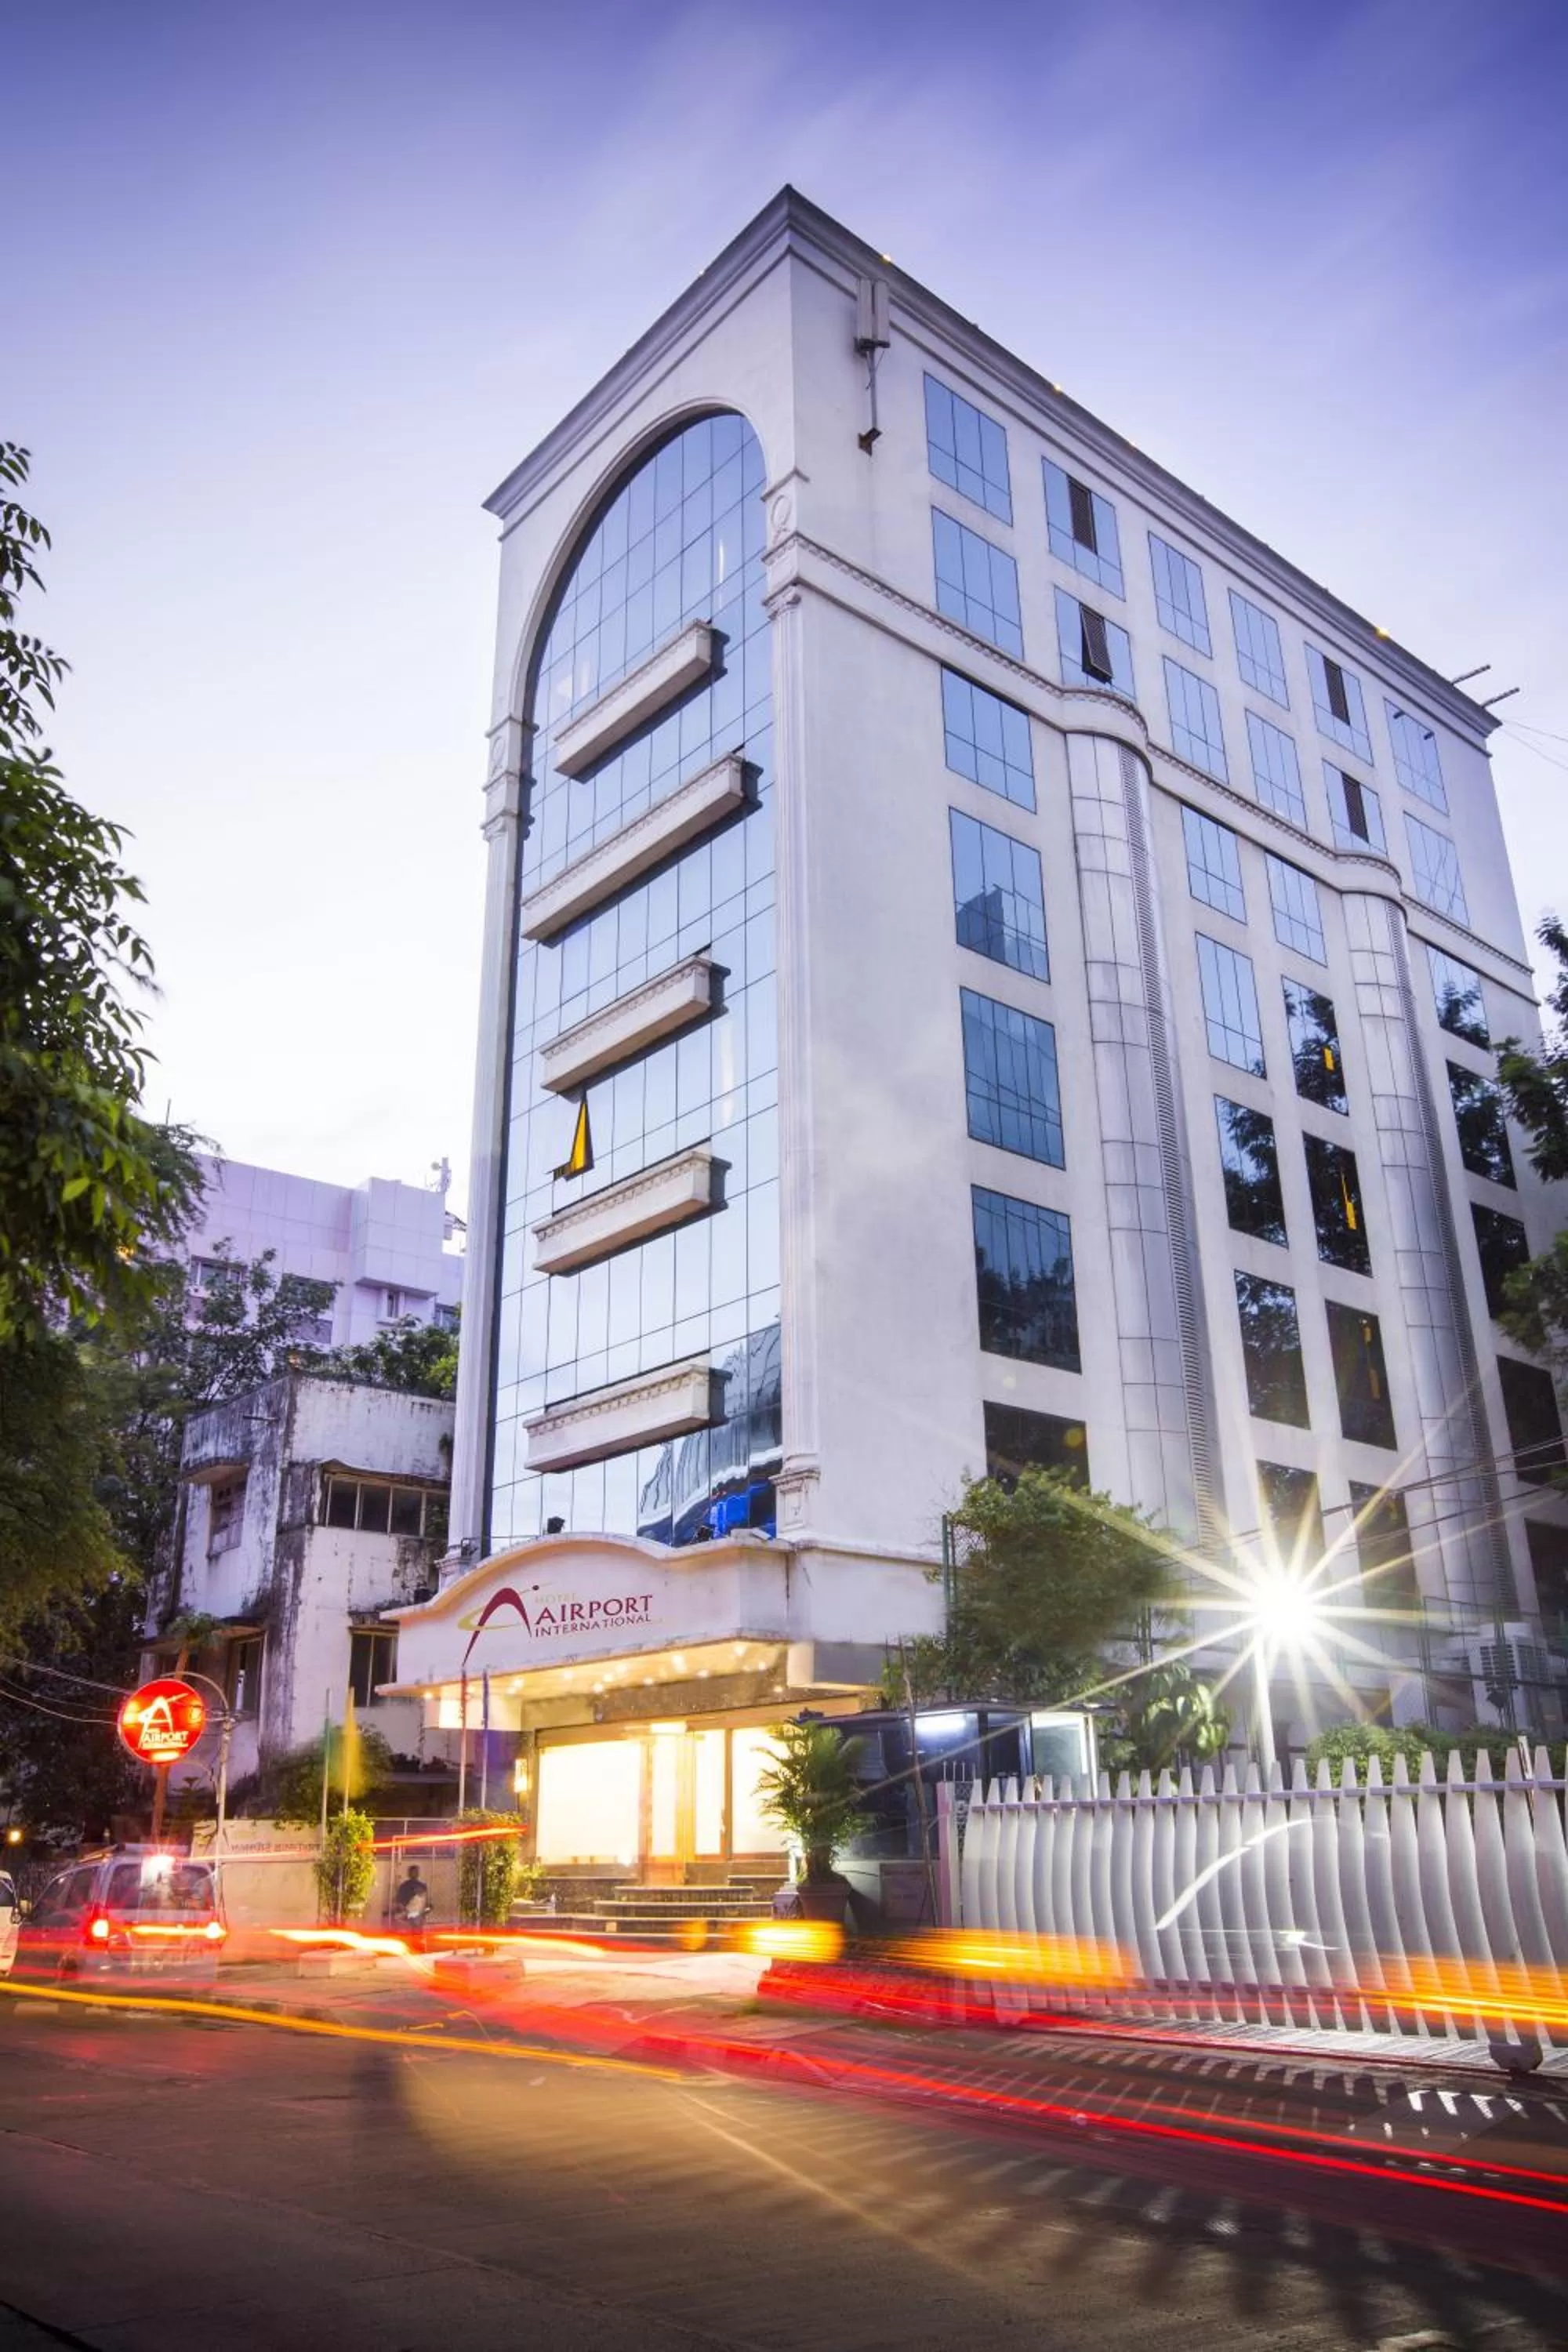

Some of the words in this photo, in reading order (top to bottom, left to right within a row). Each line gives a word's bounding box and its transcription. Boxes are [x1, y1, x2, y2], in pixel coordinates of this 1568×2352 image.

[535, 1595, 653, 1625] AIRPORT
[535, 1613, 652, 1638] INTERNATIONAL
[142, 1730, 189, 1744] AIRPORT
